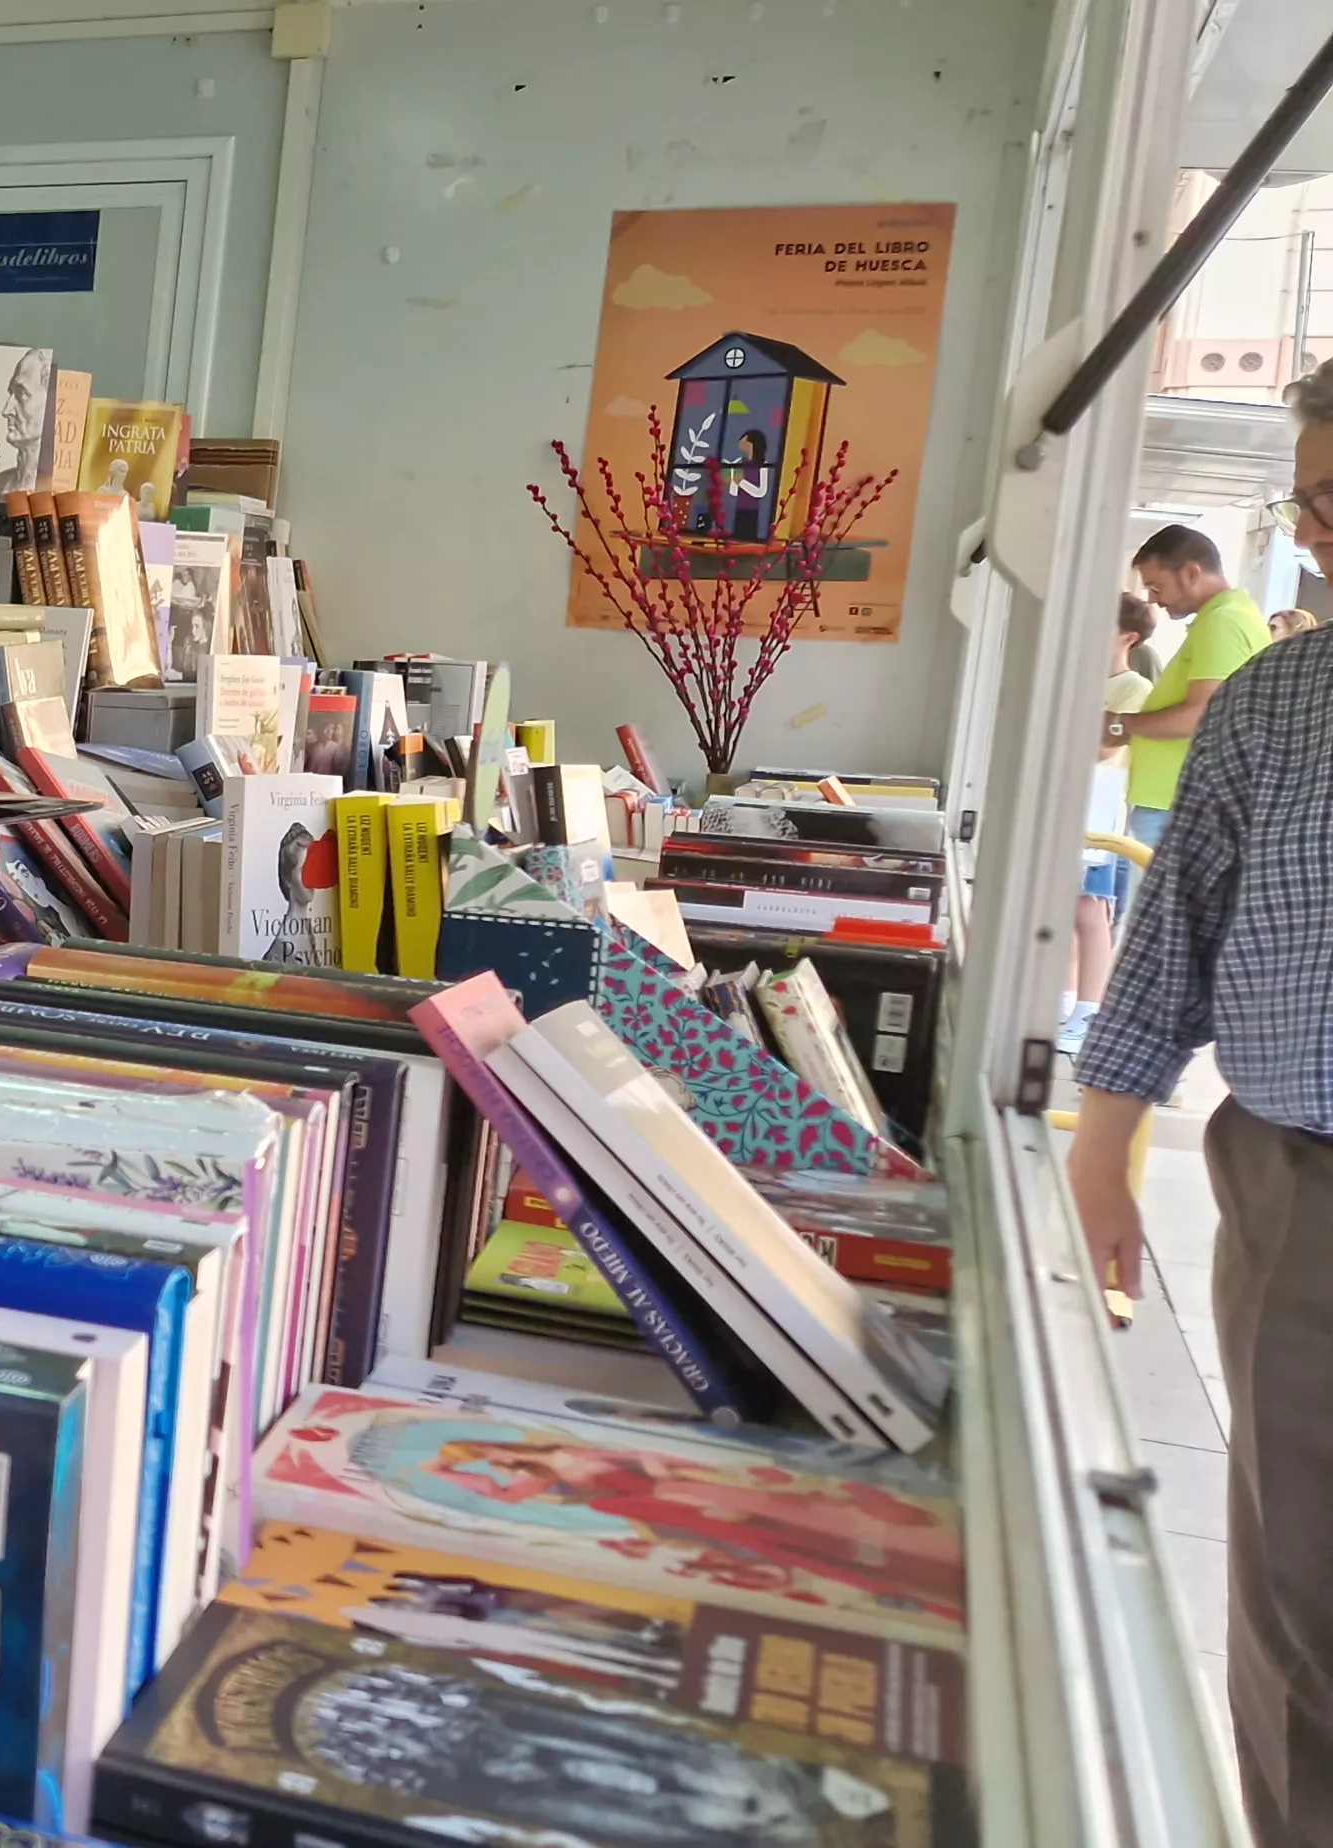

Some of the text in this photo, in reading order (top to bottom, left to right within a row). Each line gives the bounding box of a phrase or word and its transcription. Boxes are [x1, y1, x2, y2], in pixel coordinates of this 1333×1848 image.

[775, 240, 930, 257] FERIA DEL LIBRO
[824, 258, 928, 273] DE HUESCA
[102, 423, 166, 440] INGRATA
[109, 439, 156, 456] PATRIA
[270, 791, 308, 809] Virginia
[226, 803, 240, 871] Virginia Feito
[359, 814, 372, 856] LIZ NUGENT
[416, 822, 429, 864] LIZ NUGENT
[251, 908, 332, 937] Victorian
[281, 941, 342, 967] Psycho
[578, 1219, 632, 1286] MIEDO
[628, 1286, 652, 1309] AL
[644, 1307, 710, 1393] GRACIAS
